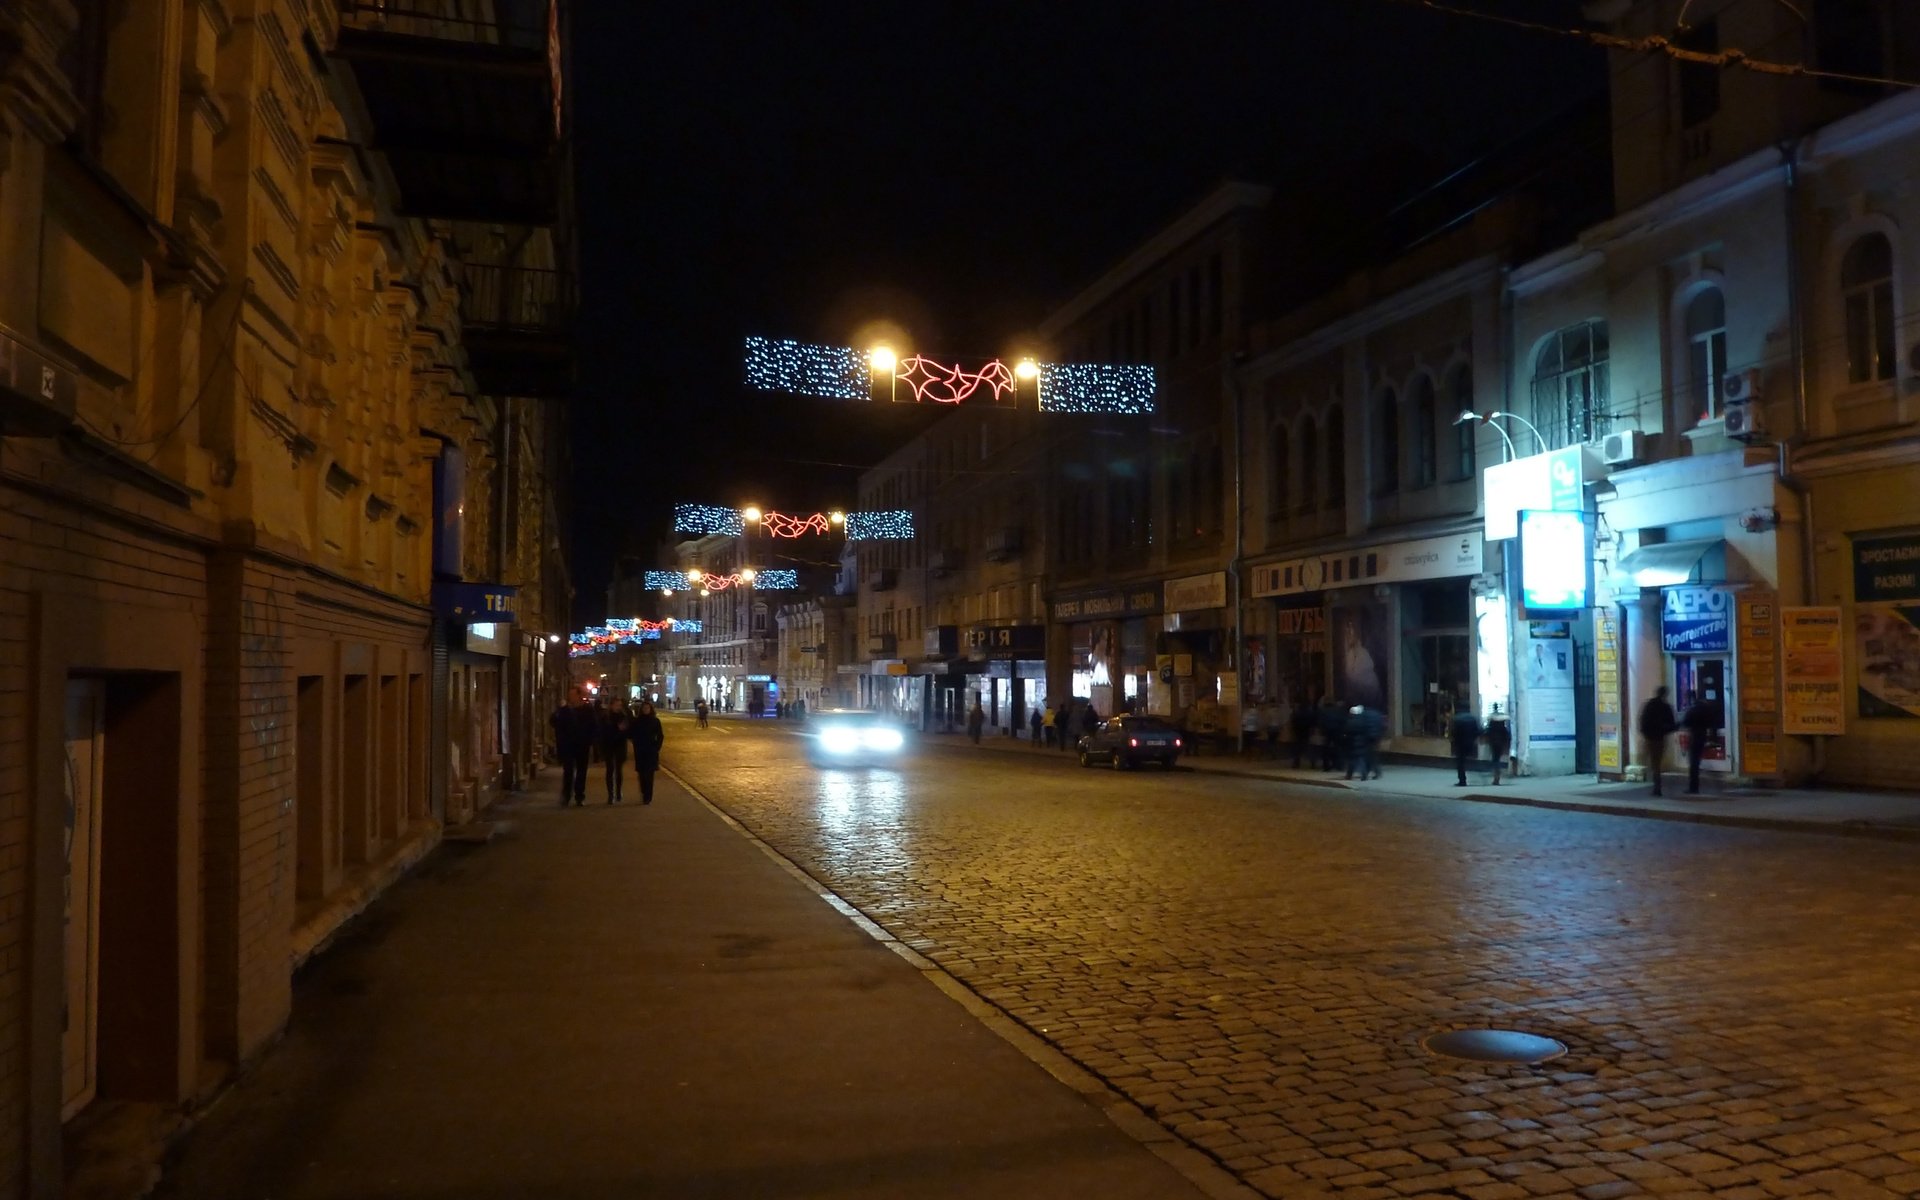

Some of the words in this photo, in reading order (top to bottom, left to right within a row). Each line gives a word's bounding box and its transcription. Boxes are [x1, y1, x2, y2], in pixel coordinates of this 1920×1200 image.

[1874, 573, 1917, 590] РАЗОМ!
[1664, 588, 1726, 613] АЕРО
[1665, 620, 1727, 650] Турагентство
